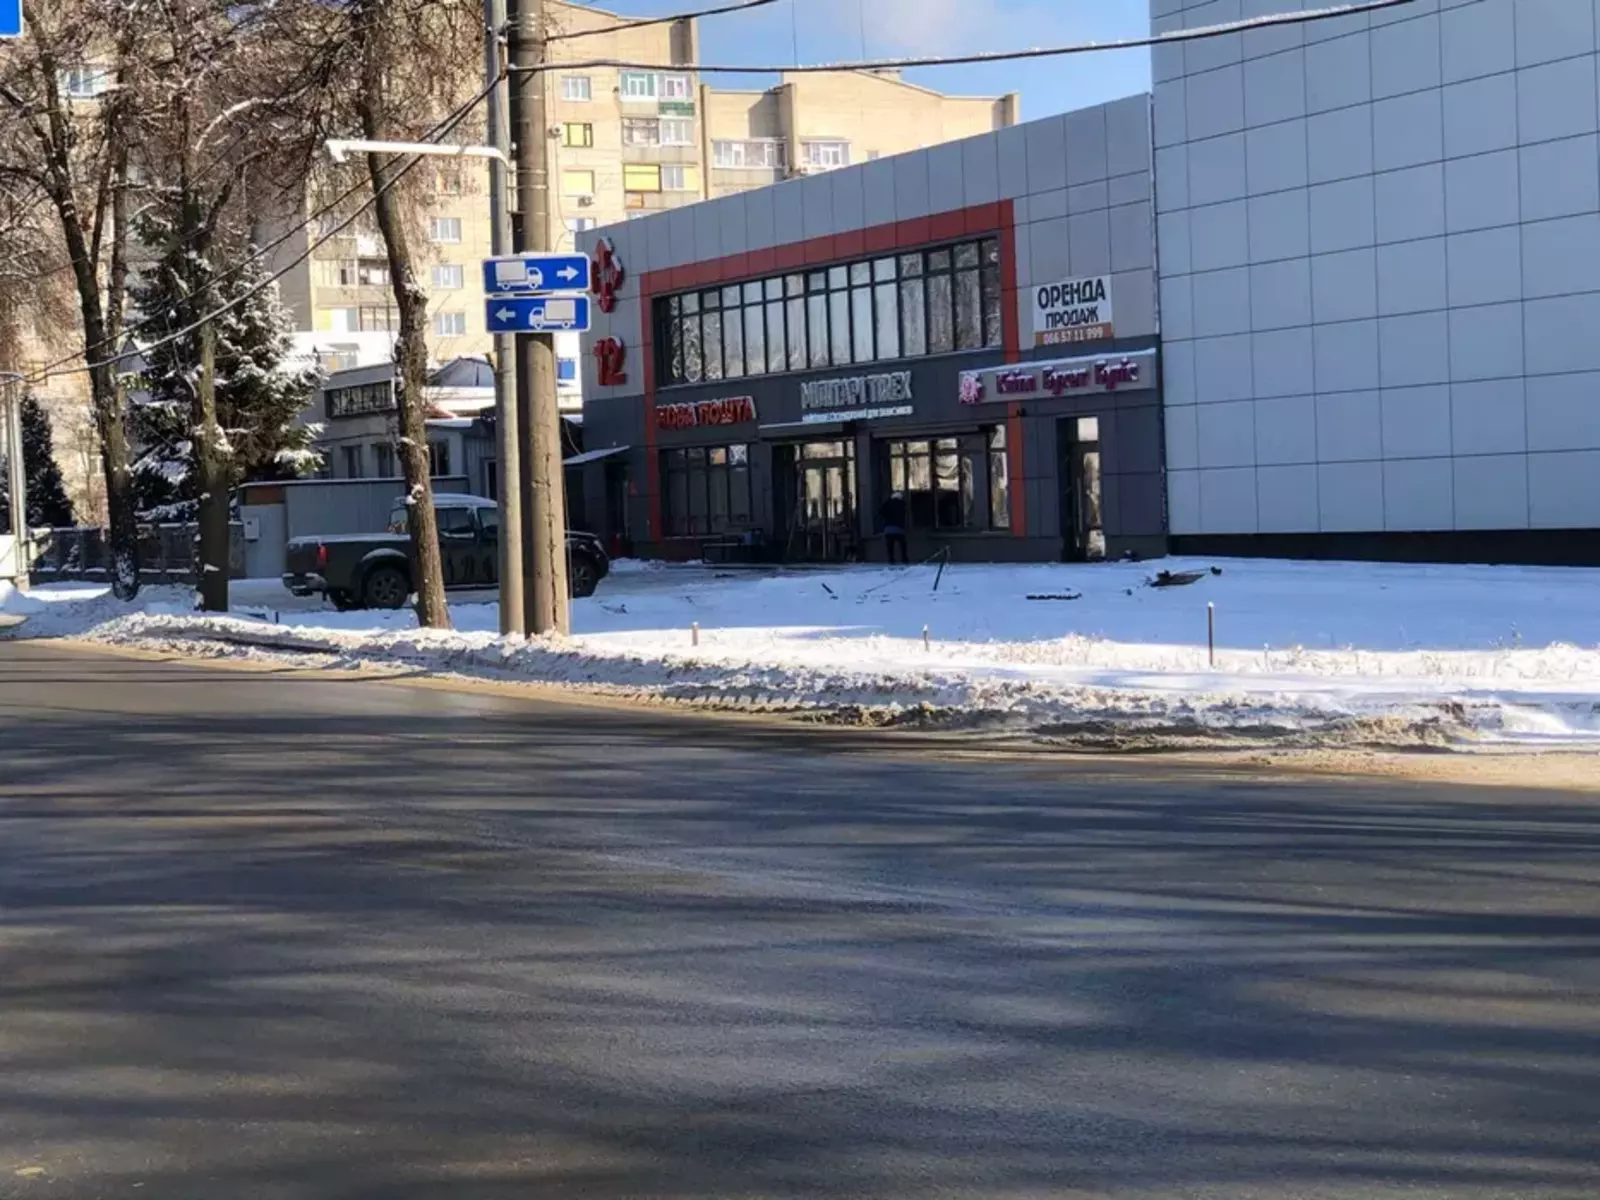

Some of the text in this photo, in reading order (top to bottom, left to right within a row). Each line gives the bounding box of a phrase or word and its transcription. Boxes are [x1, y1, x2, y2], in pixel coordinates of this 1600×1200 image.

[1038, 278, 1106, 310] ОРЕНДА
[1046, 306, 1099, 329] ПРОДАЖ
[593, 336, 628, 385] 12
[697, 396, 757, 425] ПОШТА
